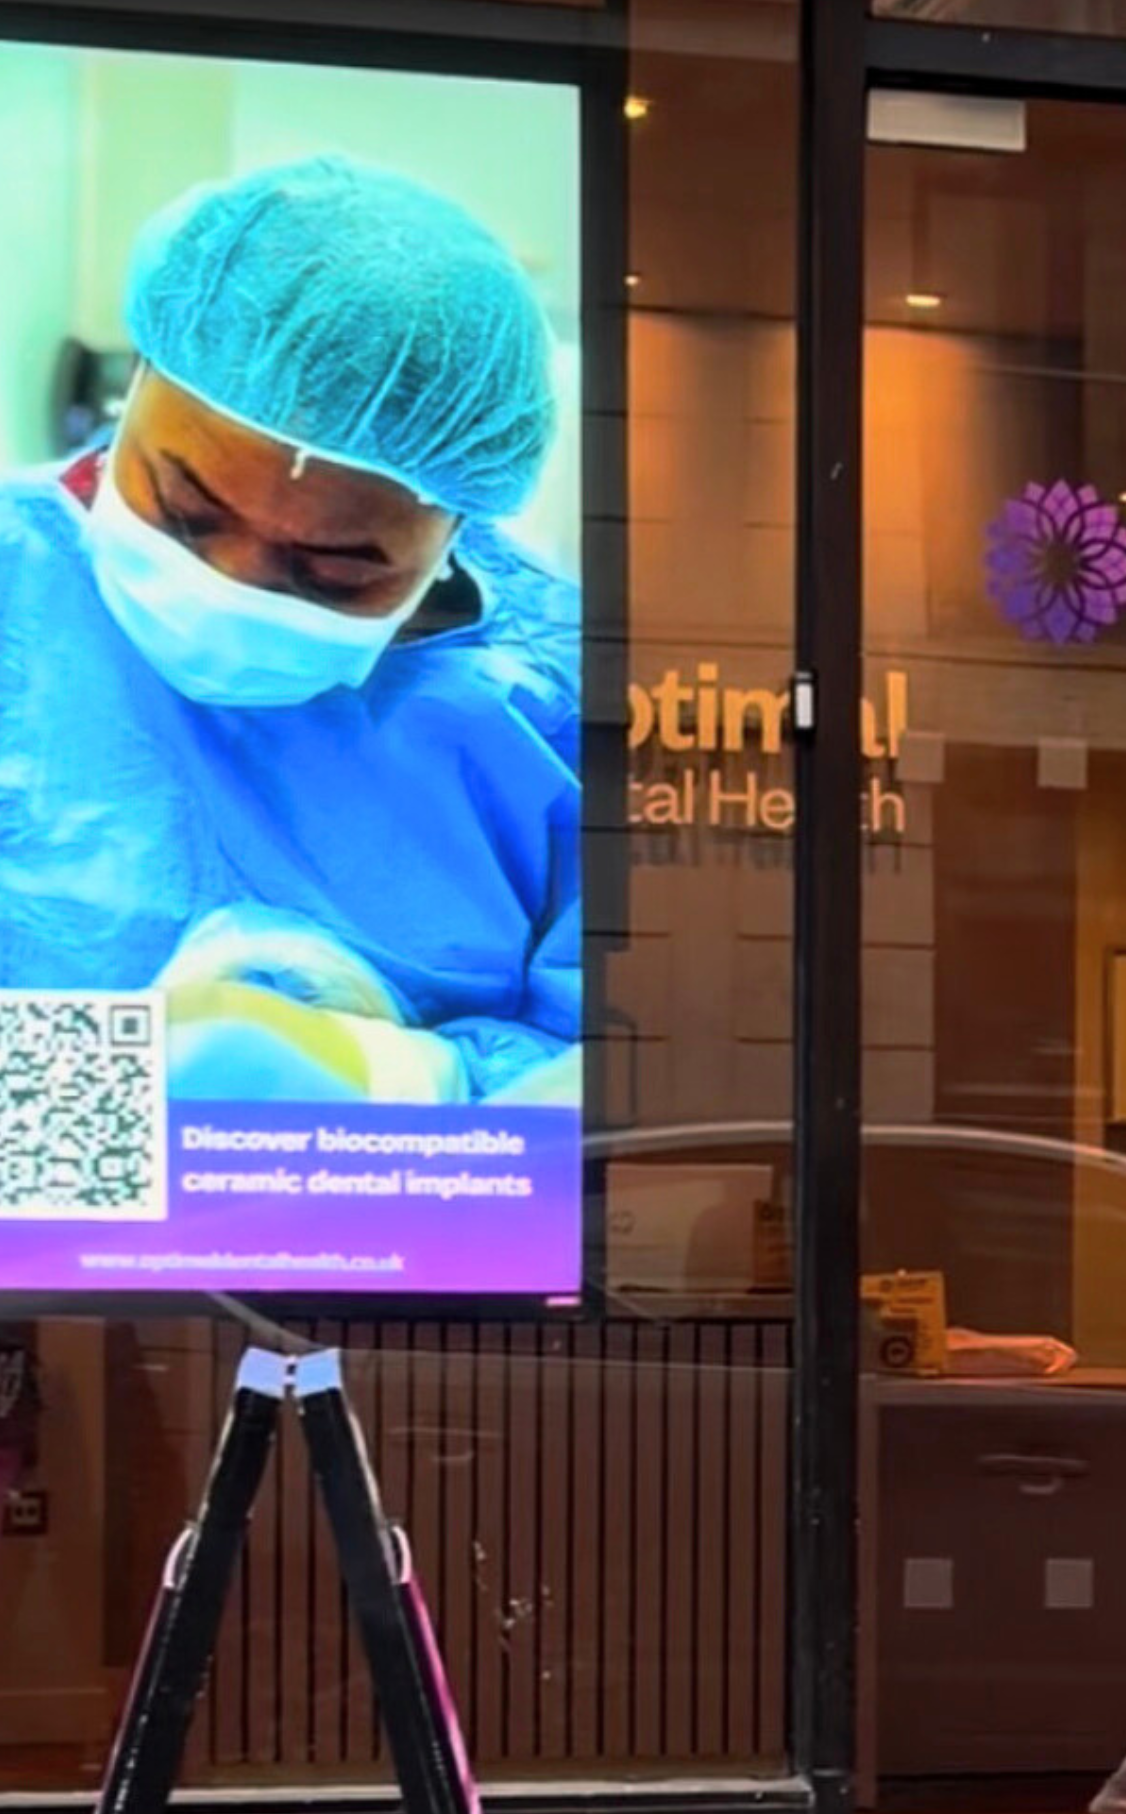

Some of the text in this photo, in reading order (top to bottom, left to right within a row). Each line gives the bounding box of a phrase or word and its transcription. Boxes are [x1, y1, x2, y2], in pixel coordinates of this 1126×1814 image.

[182, 1126, 525, 1157] Discover biocompatible
[181, 1168, 533, 1199] ceramic dental implants
